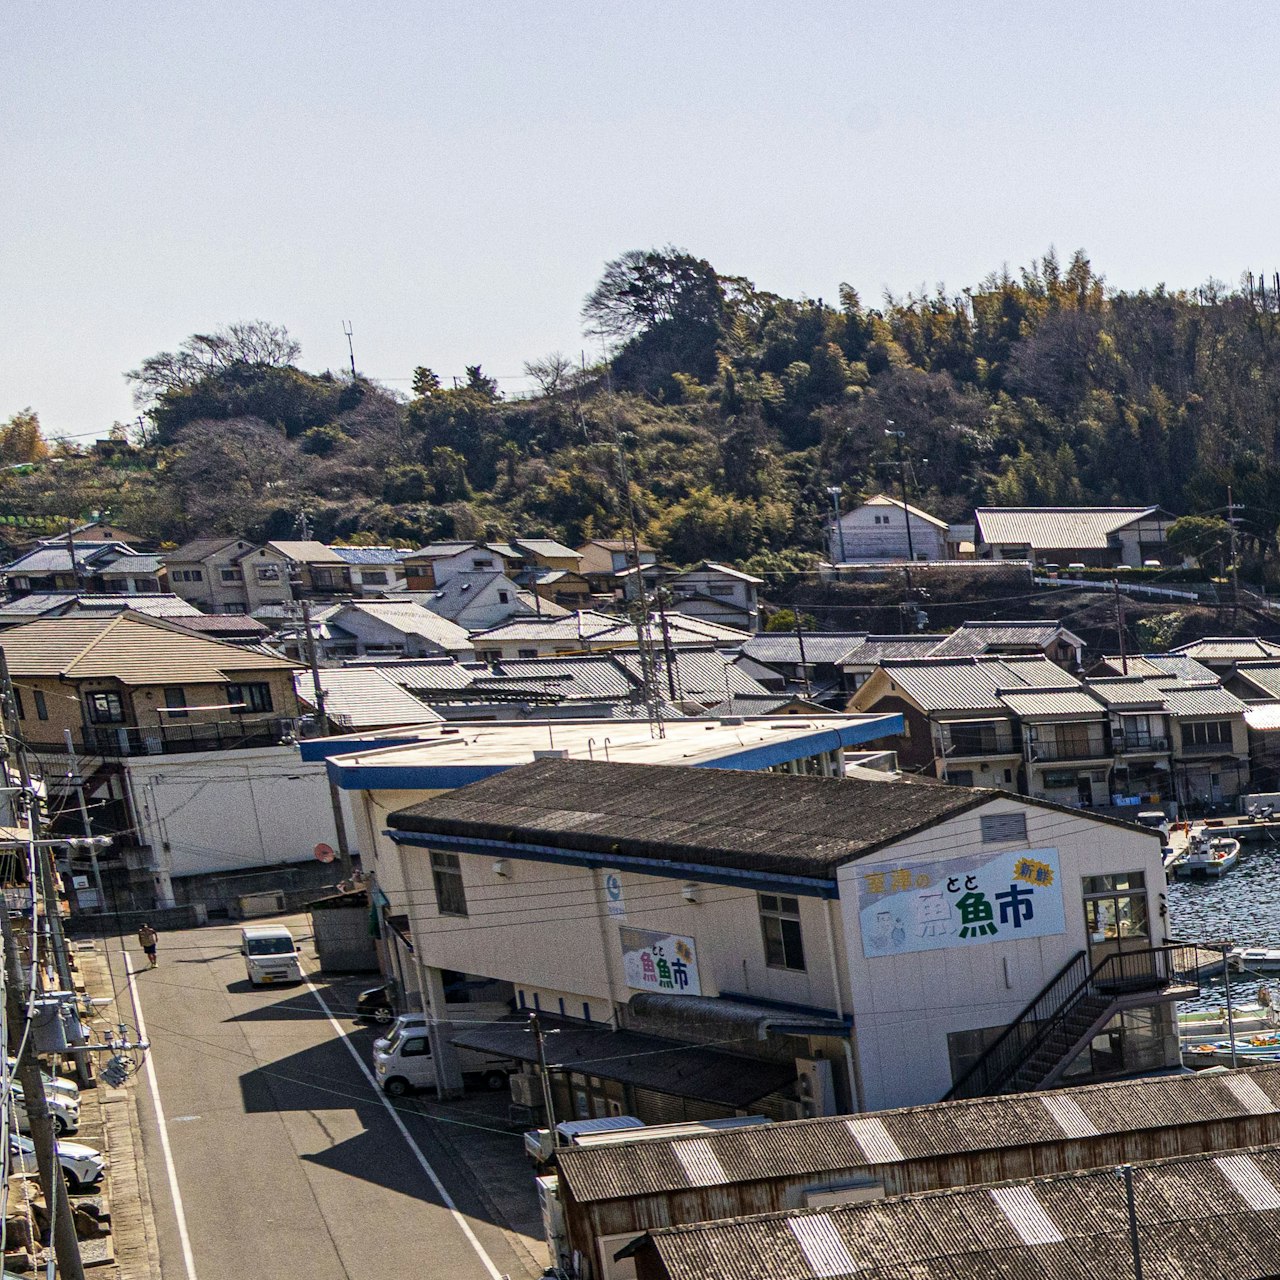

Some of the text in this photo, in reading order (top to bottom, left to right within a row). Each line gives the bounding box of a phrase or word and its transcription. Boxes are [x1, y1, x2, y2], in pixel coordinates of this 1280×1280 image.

[946, 875, 979, 893] とと
[640, 951, 688, 990] 魚魚市
